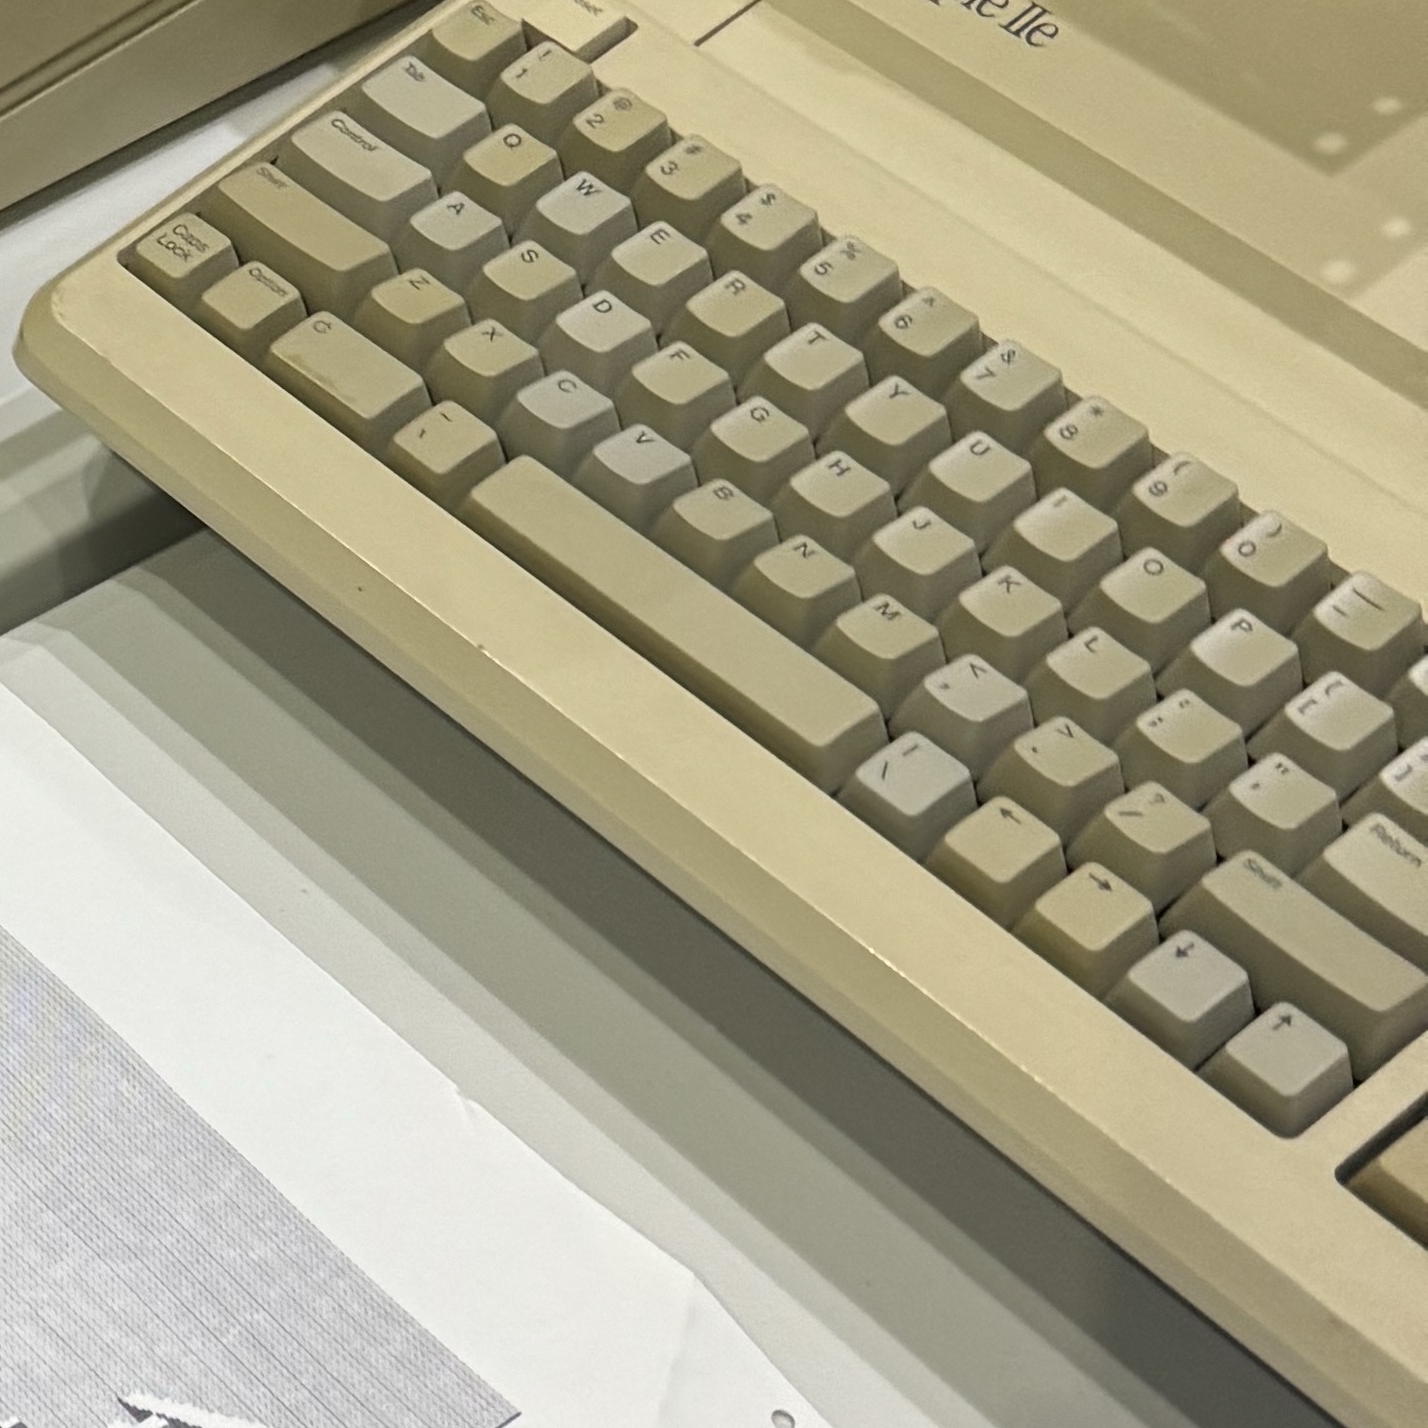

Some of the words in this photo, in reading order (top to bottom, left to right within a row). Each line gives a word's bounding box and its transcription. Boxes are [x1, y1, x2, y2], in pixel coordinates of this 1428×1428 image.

[585, 113, 605, 129] 2
[332, 118, 378, 152] Control
[577, 179, 599, 197] W
[446, 202, 466, 216] A
[172, 223, 209, 252] Caps
[649, 228, 671, 246] E
[156, 232, 191, 262] Lock
[520, 249, 540, 264] S
[813, 261, 833, 276] 5
[248, 267, 287, 295] Option
[407, 277, 430, 293] Z
[724, 277, 747, 296] R
[481, 327, 502, 343] X
[807, 330, 827, 345] T
[668, 348, 691, 361] F
[976, 366, 996, 380] 7
[557, 378, 578, 393] C
[889, 383, 909, 399] Y
[749, 406, 771, 423] G
[635, 430, 655, 445] V
[1058, 424, 1079, 441] 8
[969, 439, 992, 456] U
[827, 458, 852, 477] H
[712, 485, 734, 500] B
[1148, 480, 1169, 498] 9
[911, 519, 932, 531] J
[792, 541, 815, 559] N
[997, 573, 1022, 592] K
[875, 601, 900, 622] M
[1230, 617, 1253, 633] P
[1083, 635, 1099, 654] L
[1373, 825, 1422, 867] Return
[1243, 858, 1281, 889] Shift
